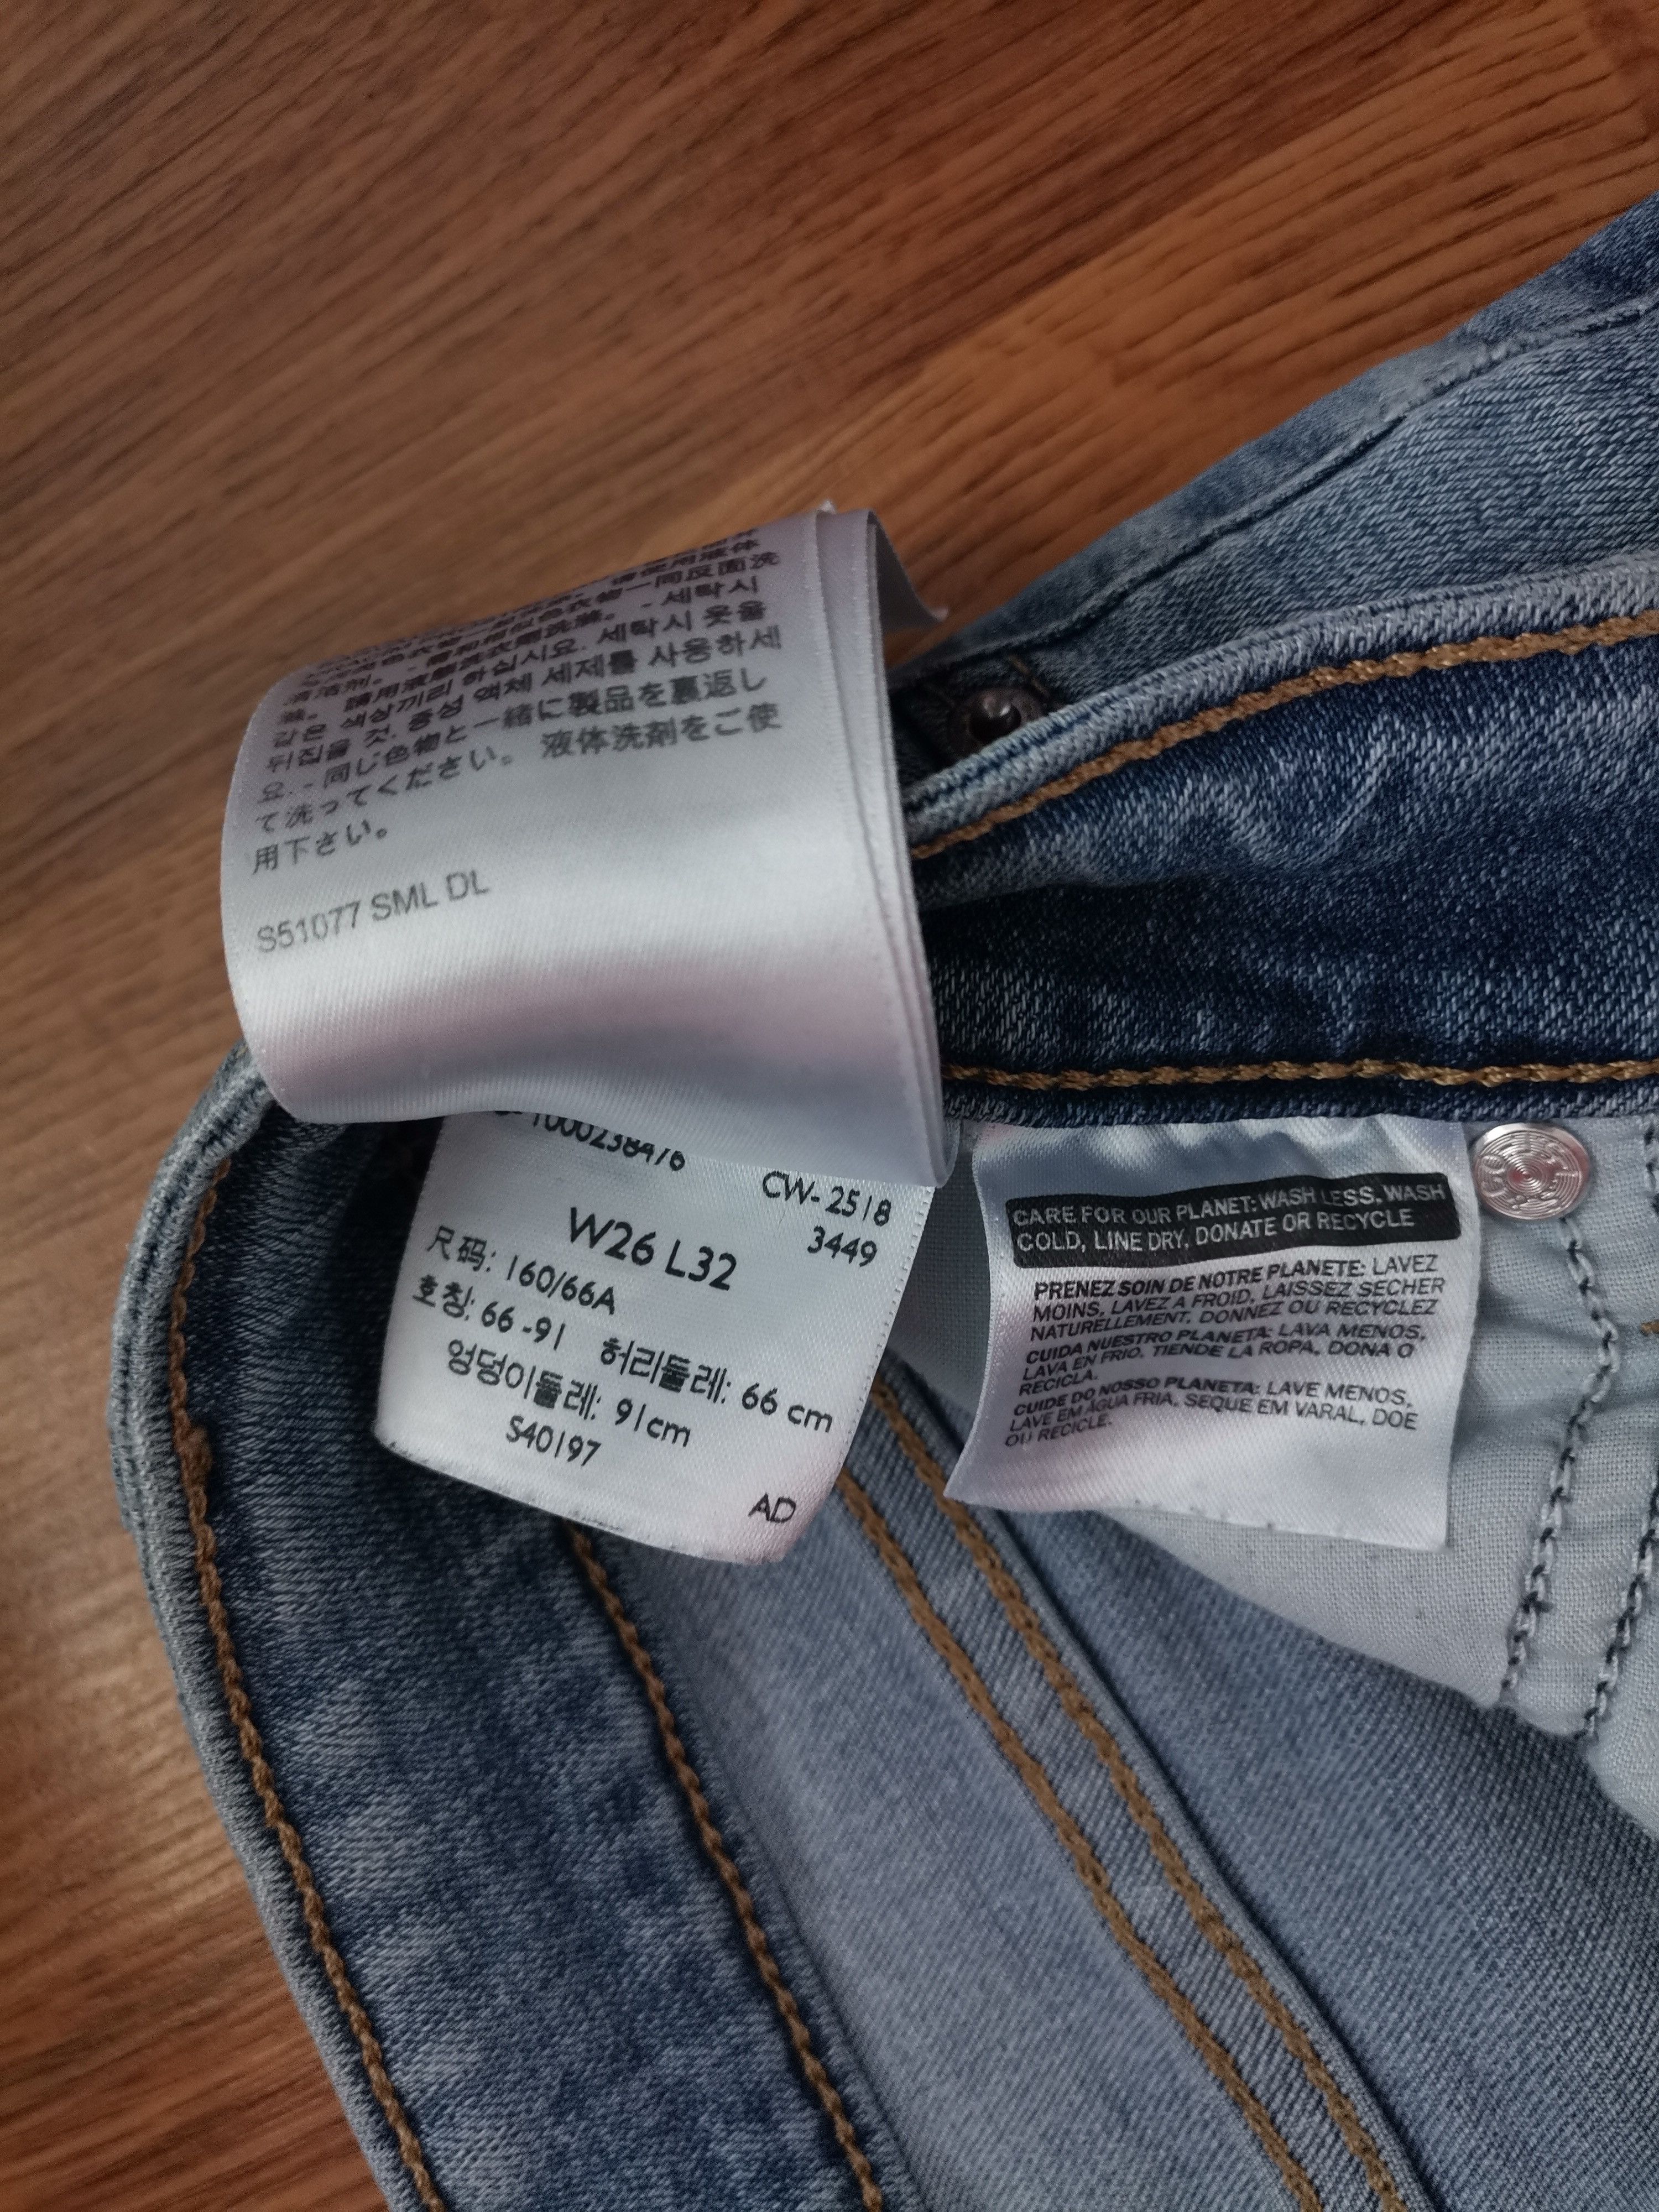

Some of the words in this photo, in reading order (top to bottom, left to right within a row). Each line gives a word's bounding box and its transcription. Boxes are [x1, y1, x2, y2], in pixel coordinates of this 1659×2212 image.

[648, 625, 782, 667] 사용하세
[257, 901, 361, 953] S51077
[371, 883, 439, 921] SML
[445, 870, 491, 901] DL
[1013, 1205, 1077, 1227] CARE
[1081, 1205, 1128, 1224] FOR
[1131, 1207, 1172, 1225] OUR
[1258, 1187, 1317, 1211] WASH
[1383, 1183, 1446, 1202] WASH
[570, 1206, 656, 1266] W26
[665, 1239, 737, 1291] L32
[807, 1225, 878, 1267] 3449
[1017, 1230, 1086, 1253] COLD,
[1094, 1230, 1143, 1252] LINE
[1196, 1217, 1277, 1246] DONATE
[1282, 1212, 1311, 1233] OR
[1317, 1208, 1415, 1231] RECYCLE
[507, 1254, 615, 1316] 160/66A
[1034, 1279, 1117, 1301] PRENEZ
[1117, 1278, 1166, 1297] SOIN
[1168, 1275, 1197, 1294] DE
[1197, 1265, 1264, 1290] NOTRE
[1373, 1254, 1438, 1276] LAVEZ
[1111, 1297, 1171, 1315] LAVEZ
[1262, 1280, 1353, 1301] LAISSEZ
[1358, 1277, 1446, 1298] SECHER
[1199, 1301, 1285, 1326] DONNEZ
[1287, 1299, 1321, 1315] OU
[1325, 1298, 1438, 1316] RECYCLEZ
[412, 1275, 474, 1321] 호칭:
[600, 1337, 732, 1404] 허리둘레:
[742, 1383, 778, 1416] 66
[787, 1404, 833, 1433] cm
[1022, 1360, 1068, 1381] LAVA
[1072, 1353, 1097, 1371] EN
[1152, 1343, 1225, 1359] TIENDE
[1227, 1345, 1253, 1359] LA
[1328, 1340, 1391, 1358] DONA
[1396, 1343, 1415, 1359] O
[1026, 1342, 1083, 1365] CUIDA
[1087, 1331, 1173, 1353] NUESTRO
[1279, 1323, 1329, 1338] LAVA
[447, 1339, 602, 1420] 엉덩이둘레:
[1013, 1392, 1069, 1416] CUIDE
[1071, 1387, 1096, 1404] DO
[1099, 1377, 1161, 1397] NOSSO
[1266, 1381, 1321, 1397] LAVE
[1009, 1411, 1054, 1433] LAVE
[1056, 1405, 1083, 1423] EM
[1184, 1392, 1254, 1413] SEQUE
[1256, 1398, 1288, 1416] EM
[1372, 1407, 1419, 1431] DOE
[505, 1415, 602, 1467] S40197
[1004, 1431, 1033, 1447] OU
[747, 1493, 797, 1524] AD
